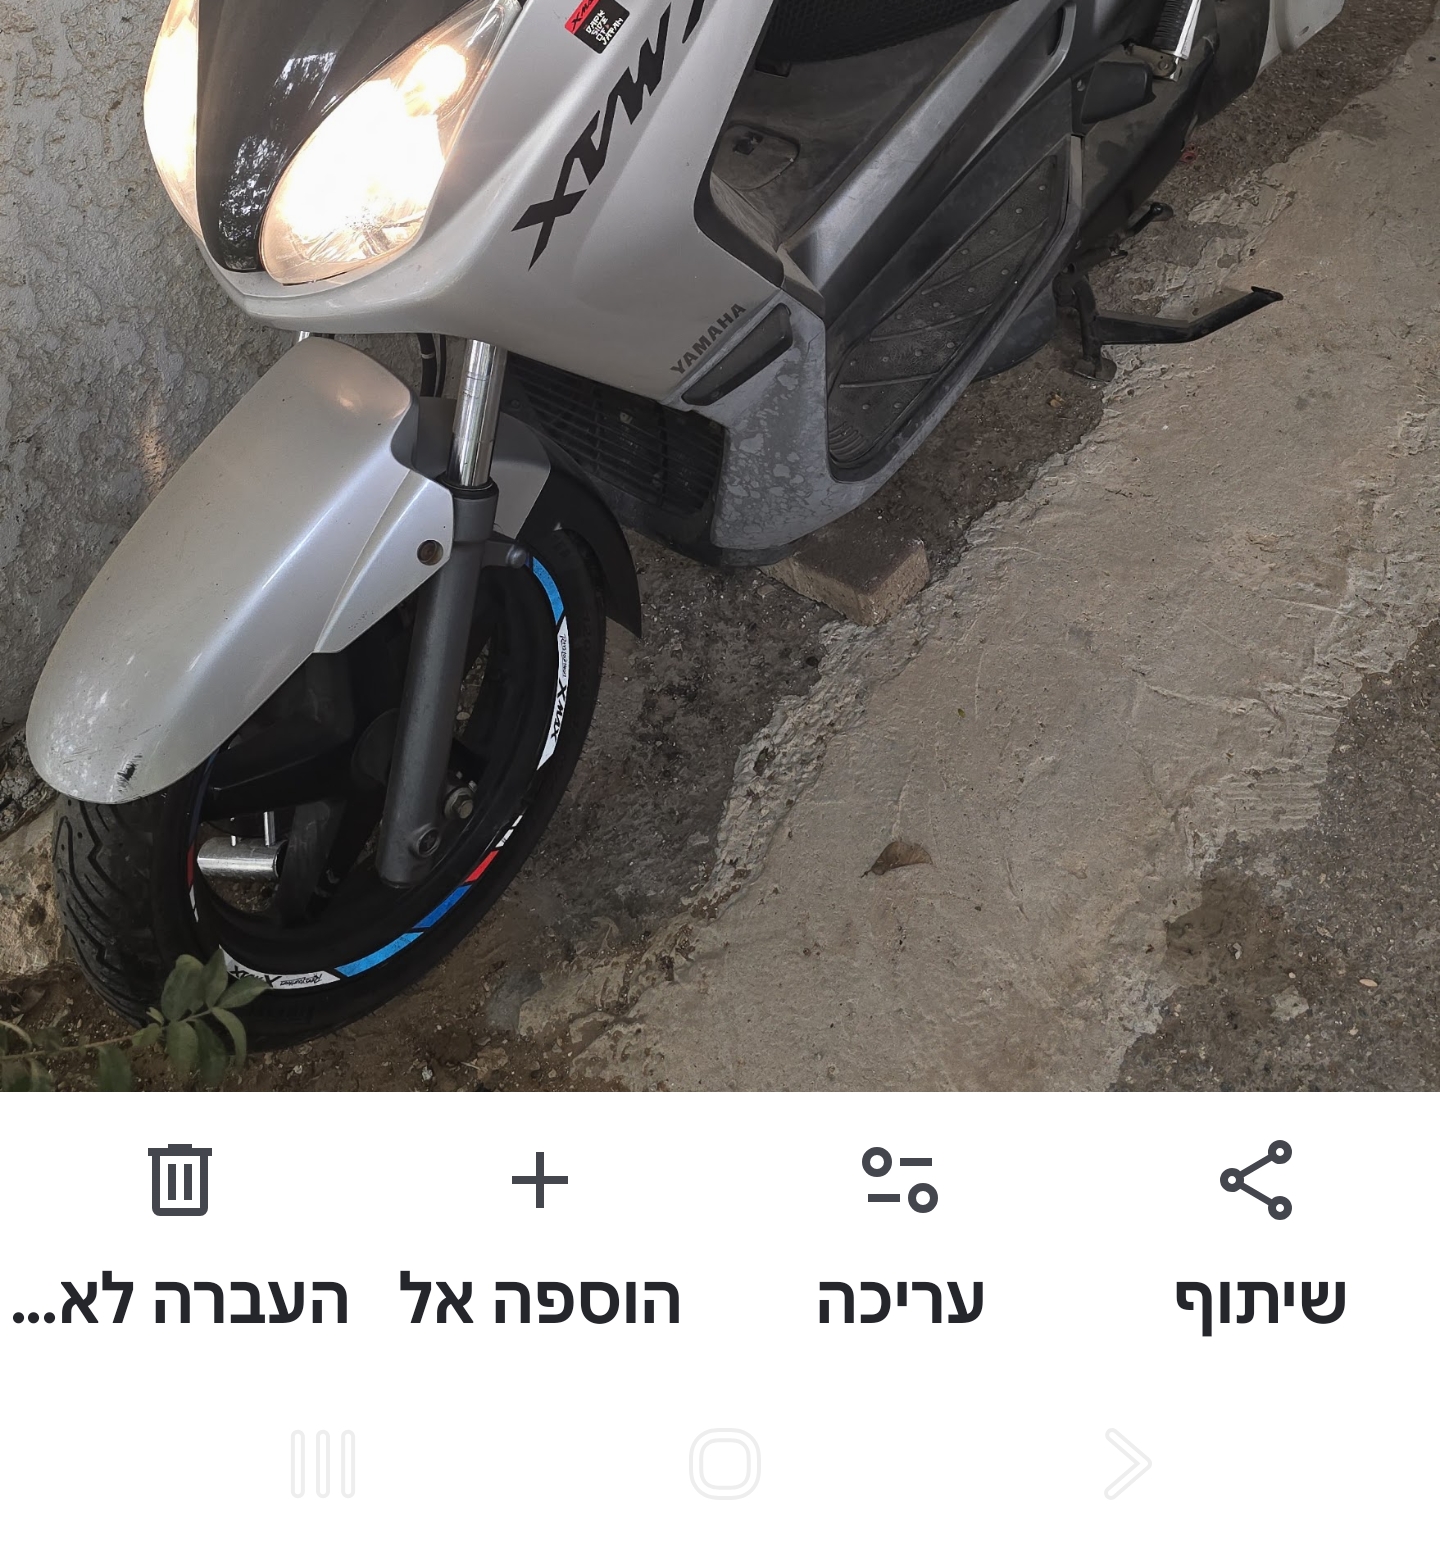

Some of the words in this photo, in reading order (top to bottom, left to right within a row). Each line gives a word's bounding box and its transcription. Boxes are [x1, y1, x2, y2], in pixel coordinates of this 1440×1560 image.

[585, 9, 605, 34] DARK
[591, 16, 609, 35] SIDE
[602, 17, 624, 46] JAPAN
[670, 303, 747, 375] YAMAHA
